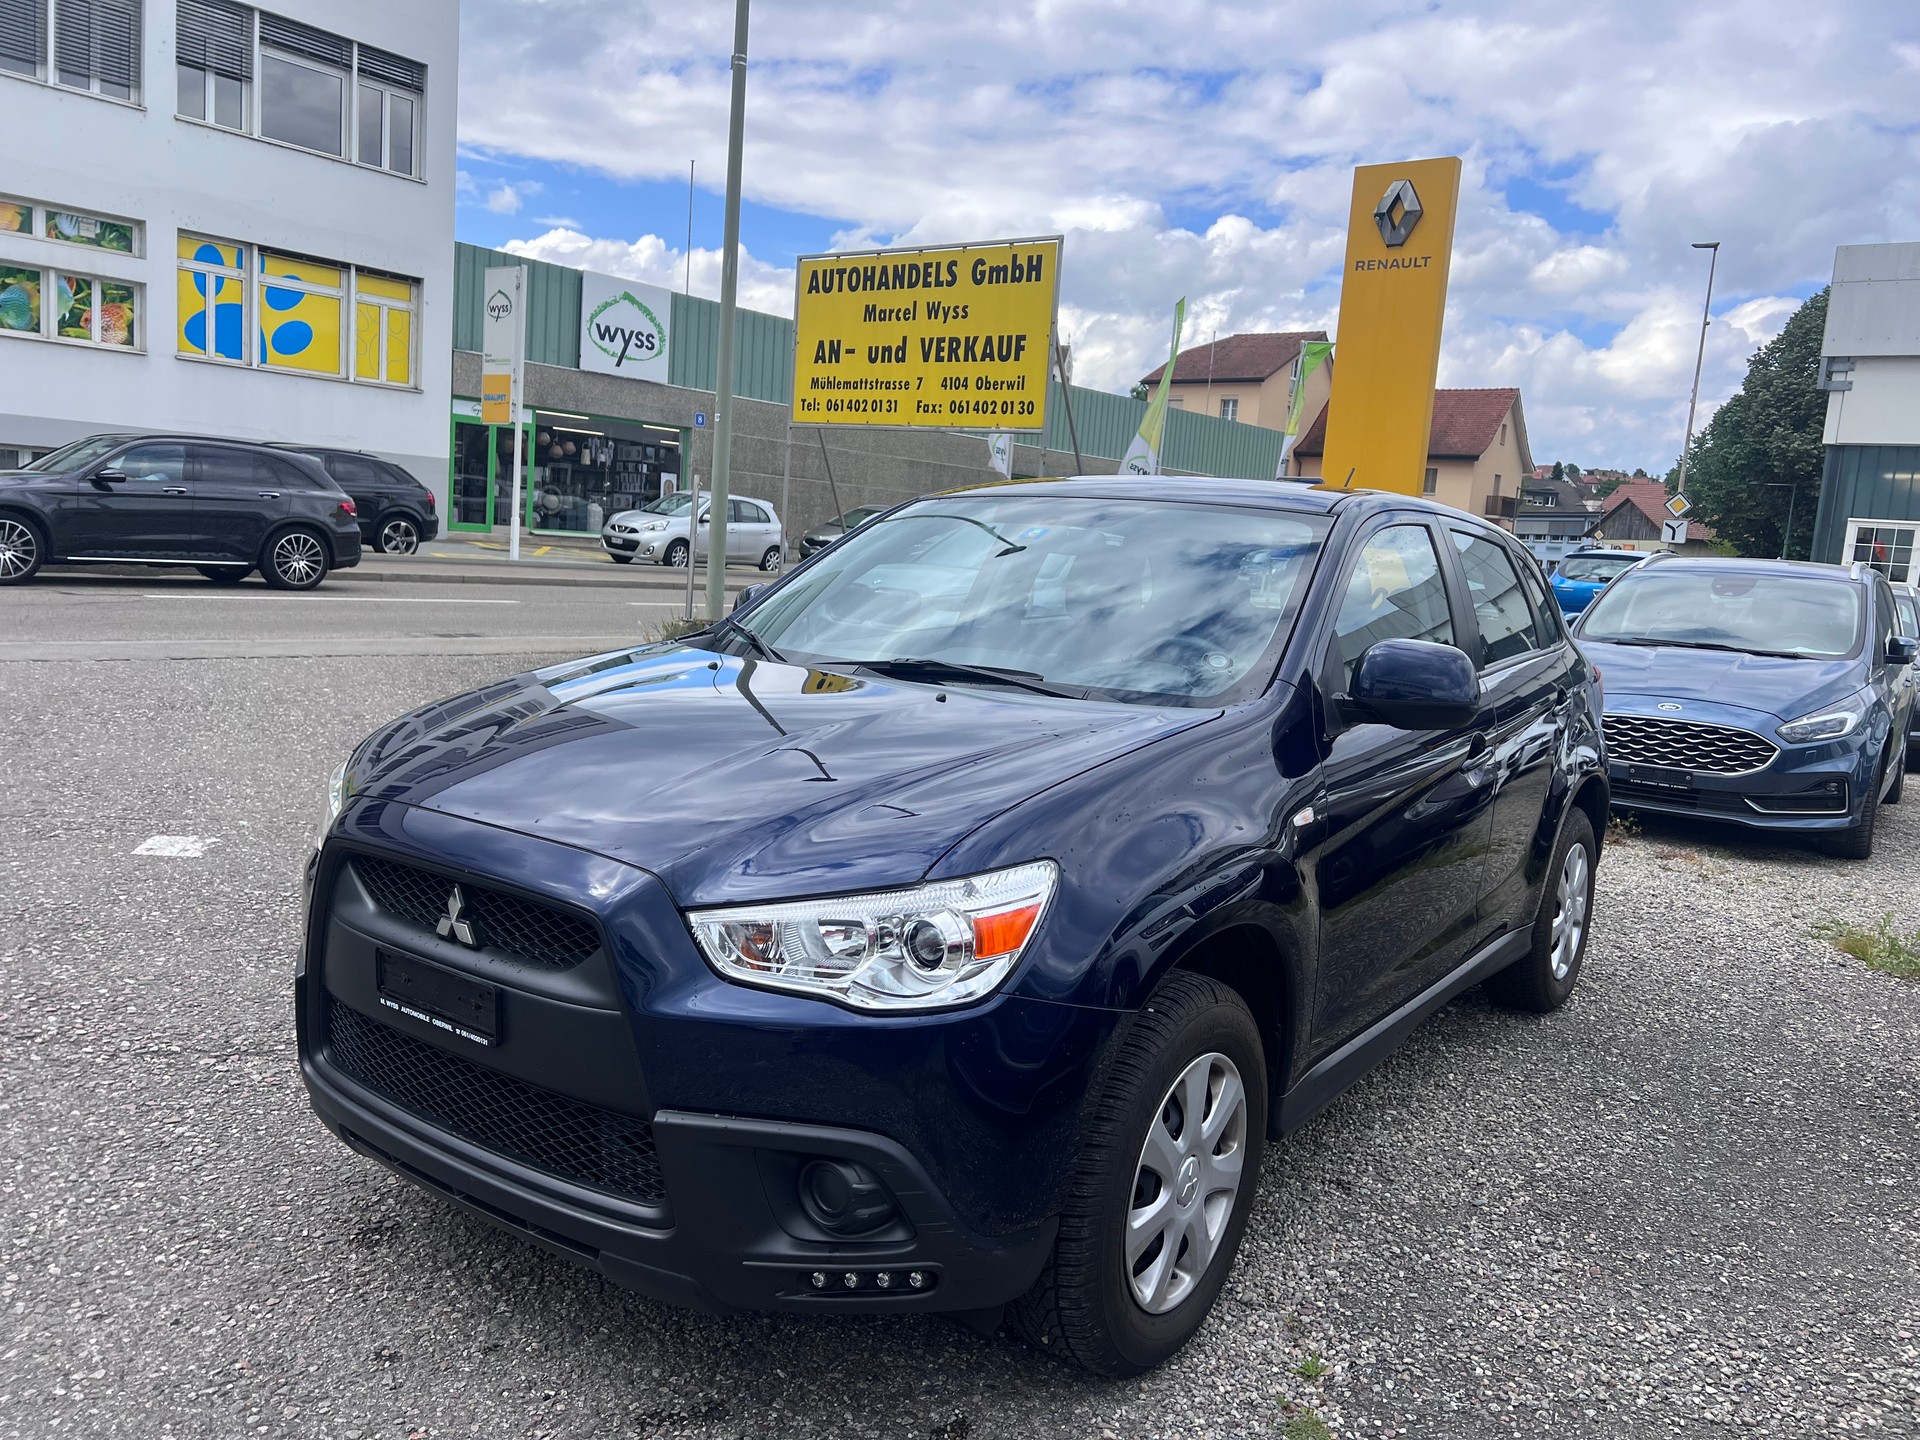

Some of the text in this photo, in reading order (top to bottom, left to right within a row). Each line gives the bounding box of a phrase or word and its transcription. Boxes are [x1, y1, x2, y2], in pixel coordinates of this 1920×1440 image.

[1355, 256, 1432, 271] RENAULT
[807, 254, 1043, 294] AUTOHANDELS GmbH
[489, 304, 509, 322] wyss
[863, 301, 969, 324] Marcel Wyss
[595, 323, 655, 367] wyss
[868, 335, 908, 363] und
[920, 334, 1027, 363] VERKAUF
[810, 375, 1026, 391] Mühlemattstrasse 7 4104 Oberwil
[801, 398, 820, 411] Tel:
[916, 400, 942, 414] Fax:
[401, 1006, 430, 1023] AUTOMOBILE
